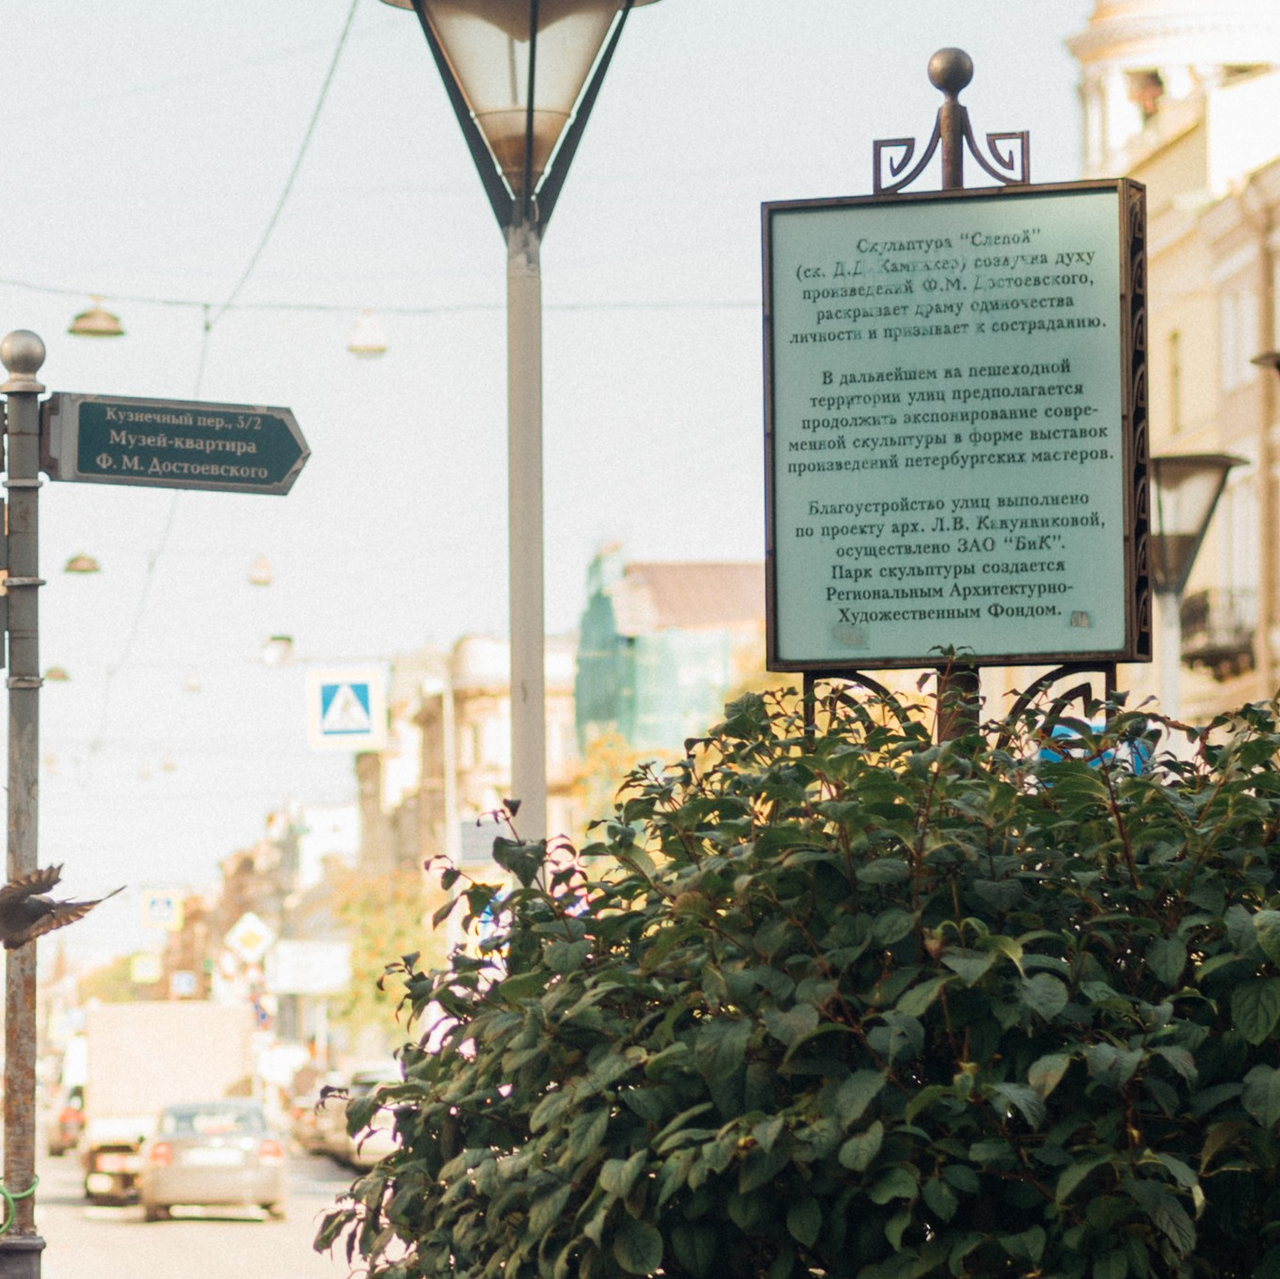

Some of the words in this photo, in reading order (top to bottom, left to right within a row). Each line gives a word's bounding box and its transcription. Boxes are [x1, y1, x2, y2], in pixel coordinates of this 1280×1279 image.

[833, 260, 872, 279] Д.Д
[1055, 250, 1096, 267] духу
[914, 302, 964, 318] драму
[970, 296, 1075, 314] одиночества
[789, 330, 862, 344] личности
[868, 329, 878, 340] и
[884, 323, 969, 342] призывает
[976, 322, 985, 333] к
[991, 317, 1106, 335] состраданию.
[821, 370, 834, 386] В
[839, 366, 938, 386] дальнейшем
[944, 367, 963, 379] на
[968, 358, 1071, 378] пешеходной
[810, 392, 901, 410] территории
[908, 390, 946, 406] улиц
[952, 384, 1084, 404] предполагается
[106, 408, 193, 425] Кузнечный
[237, 415, 262, 430] 5/2
[801, 414, 898, 433] продолжить
[903, 408, 1038, 425] экспонирование
[1044, 405, 1099, 421] совре-
[110, 430, 256, 456] Музей-квартира
[788, 435, 846, 452] менной
[852, 434, 947, 451] скульптуры
[953, 433, 963, 444] в
[968, 428, 1023, 446] форме
[1030, 426, 1108, 441] выставок
[96, 453, 116, 468] Ф.
[122, 455, 143, 470] М.
[149, 458, 268, 478] Достоевского
[788, 454, 899, 477] произведений
[905, 450, 1027, 471] петербургских
[1031, 449, 1114, 465] мастеров.
[808, 496, 945, 518] Благоустройство
[951, 497, 990, 514] улиц
[997, 494, 1089, 508] выполнено
[795, 527, 814, 538] по
[821, 524, 885, 540] проекту
[891, 522, 925, 537] арх.
[931, 516, 969, 532] Л.В.
[835, 543, 950, 561] осуществлено
[957, 537, 996, 554] ЗАО
[831, 564, 873, 582] Парк
[879, 564, 976, 581] скульптуры
[982, 560, 1066, 575] создается
[825, 586, 944, 602] Региональным
[949, 582, 1074, 601] Архитектурно-
[838, 608, 981, 628] Художественным
[987, 603, 1062, 618] Фондом.
